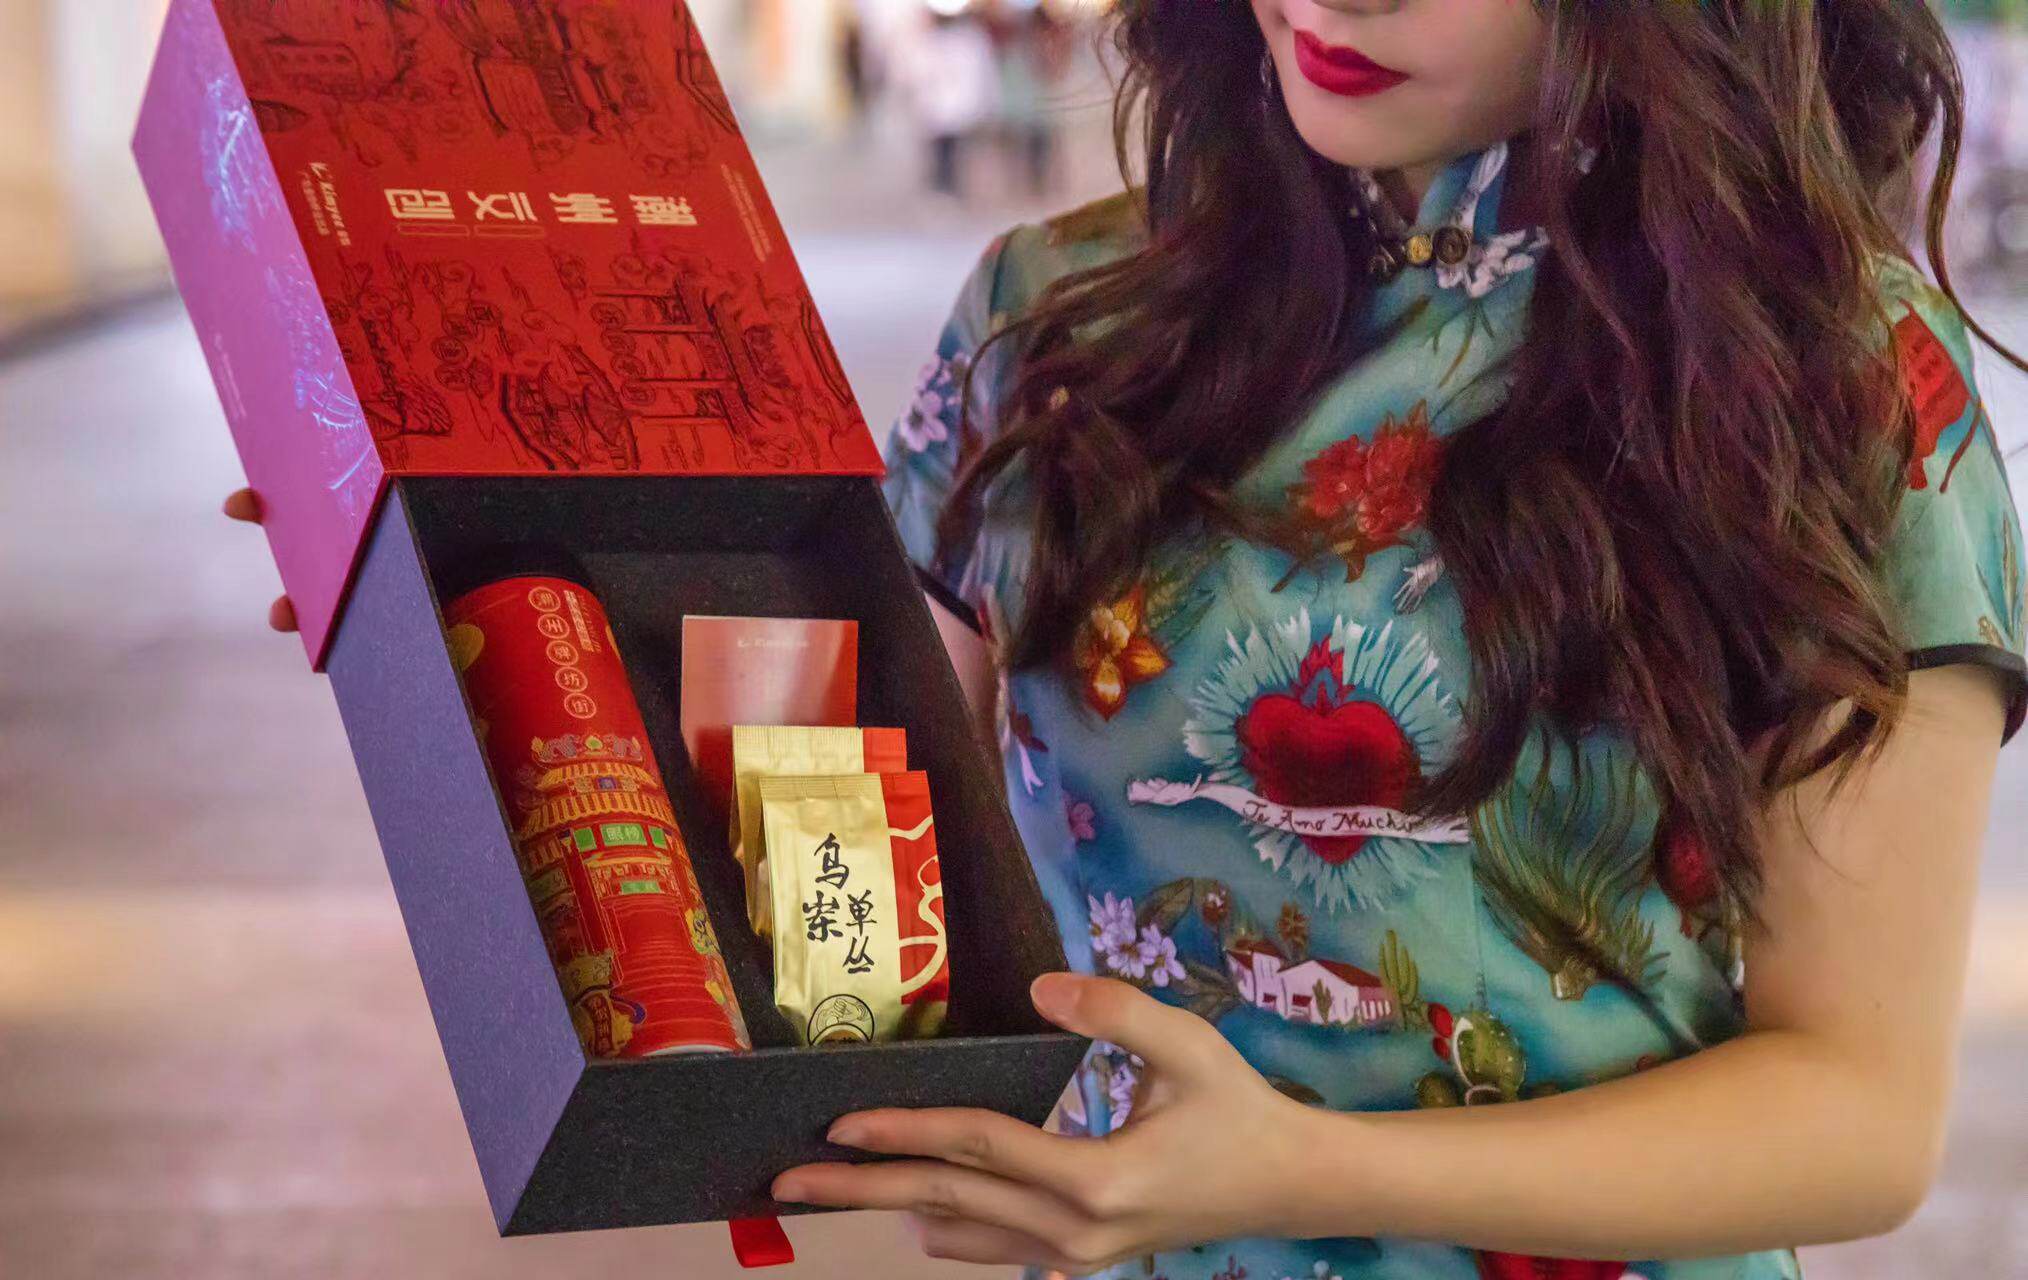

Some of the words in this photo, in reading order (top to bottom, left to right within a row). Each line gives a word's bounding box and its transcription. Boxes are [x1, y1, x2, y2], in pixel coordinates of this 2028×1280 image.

[383, 188, 698, 225] 潮州文创
[1243, 799, 1269, 824] Te
[1274, 809, 1326, 831] Amo
[842, 889, 877, 974] 单丛
